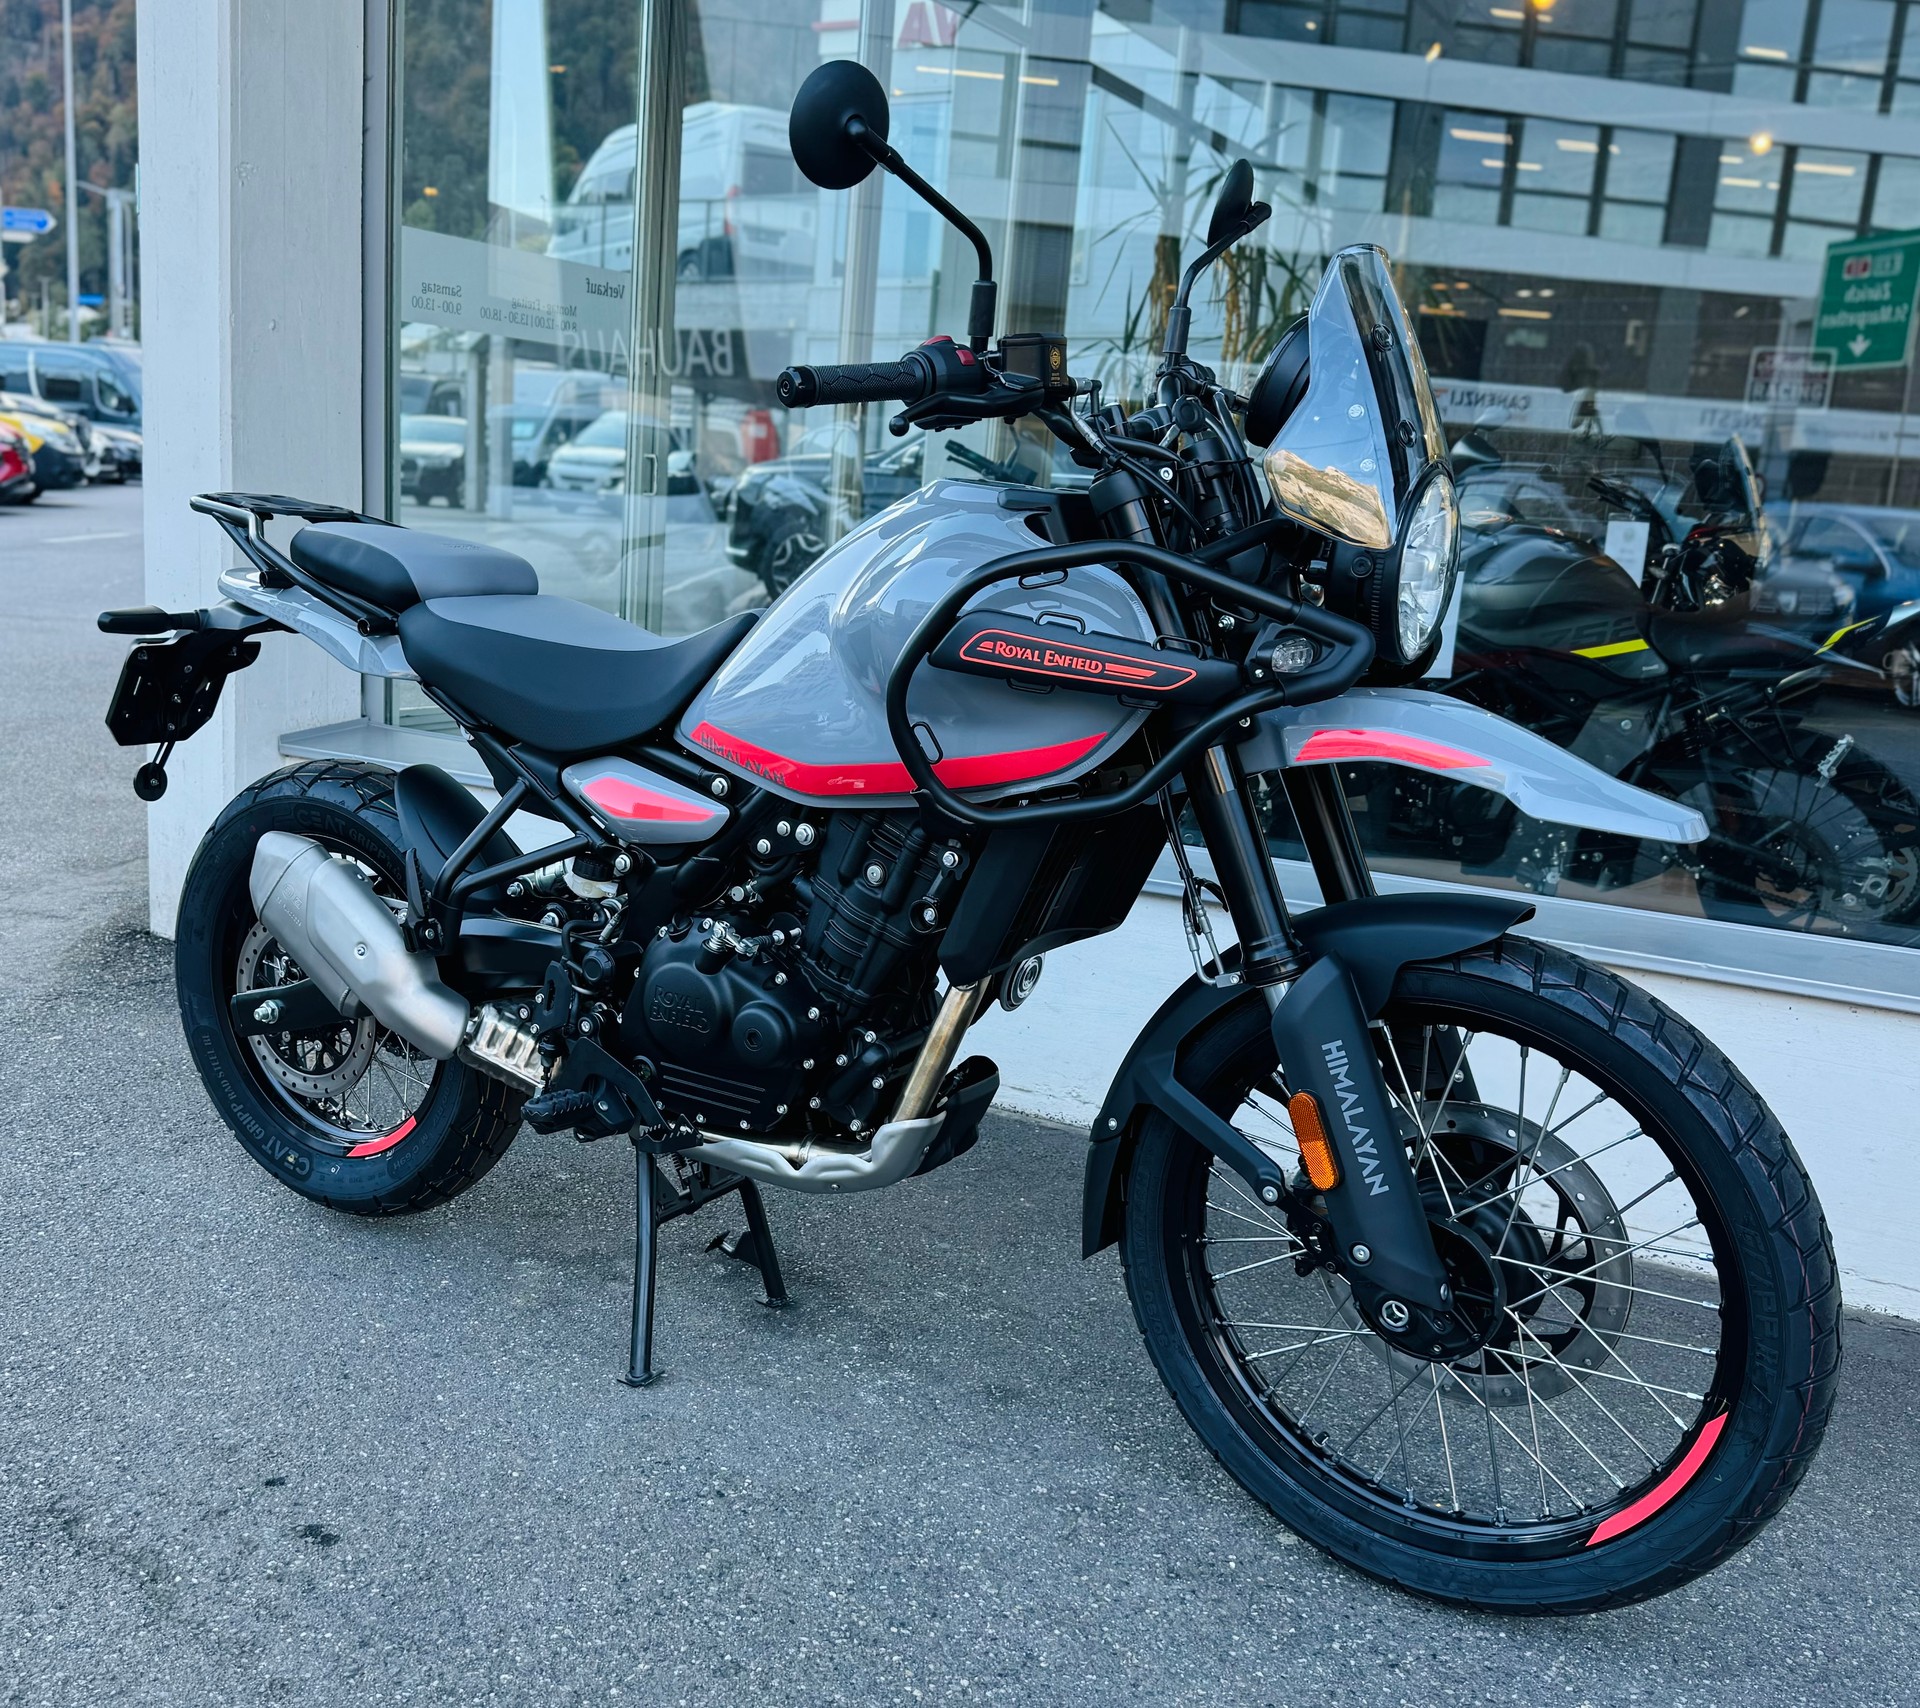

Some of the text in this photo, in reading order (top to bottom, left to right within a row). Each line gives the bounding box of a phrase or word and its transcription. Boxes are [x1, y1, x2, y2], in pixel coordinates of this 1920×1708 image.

[994, 640, 1103, 674] ROYAL ENFIELD
[701, 731, 786, 786] HIMALAYAN
[296, 808, 346, 835] CEAT
[348, 828, 388, 860] GRIPP
[230, 1099, 266, 1141] GRIPP
[1321, 1039, 1390, 1196] HIMALAYAN
[261, 1134, 311, 1177] CEAT
